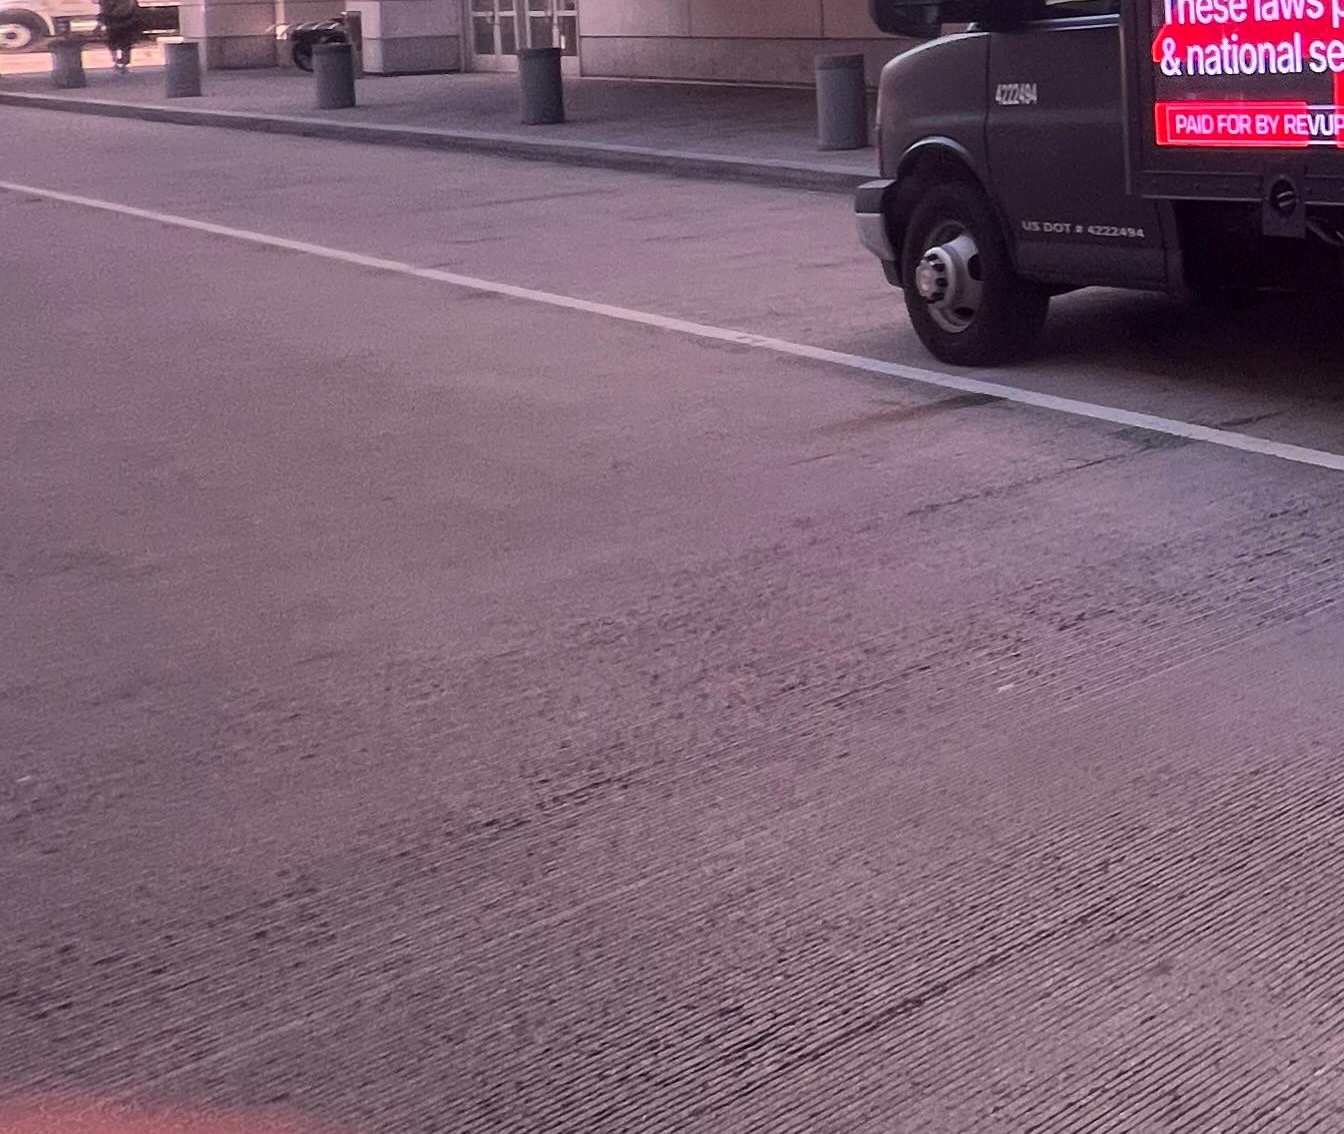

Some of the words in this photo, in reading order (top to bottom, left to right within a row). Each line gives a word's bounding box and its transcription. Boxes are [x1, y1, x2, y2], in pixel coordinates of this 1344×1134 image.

[1160, 38, 1182, 76] &
[1186, 32, 1304, 76] national
[1175, 115, 1214, 136] PAID
[1217, 115, 1251, 136] FOR
[1255, 114, 1281, 135] BY
[1022, 220, 1041, 233] US
[1043, 221, 1072, 235] DOT
